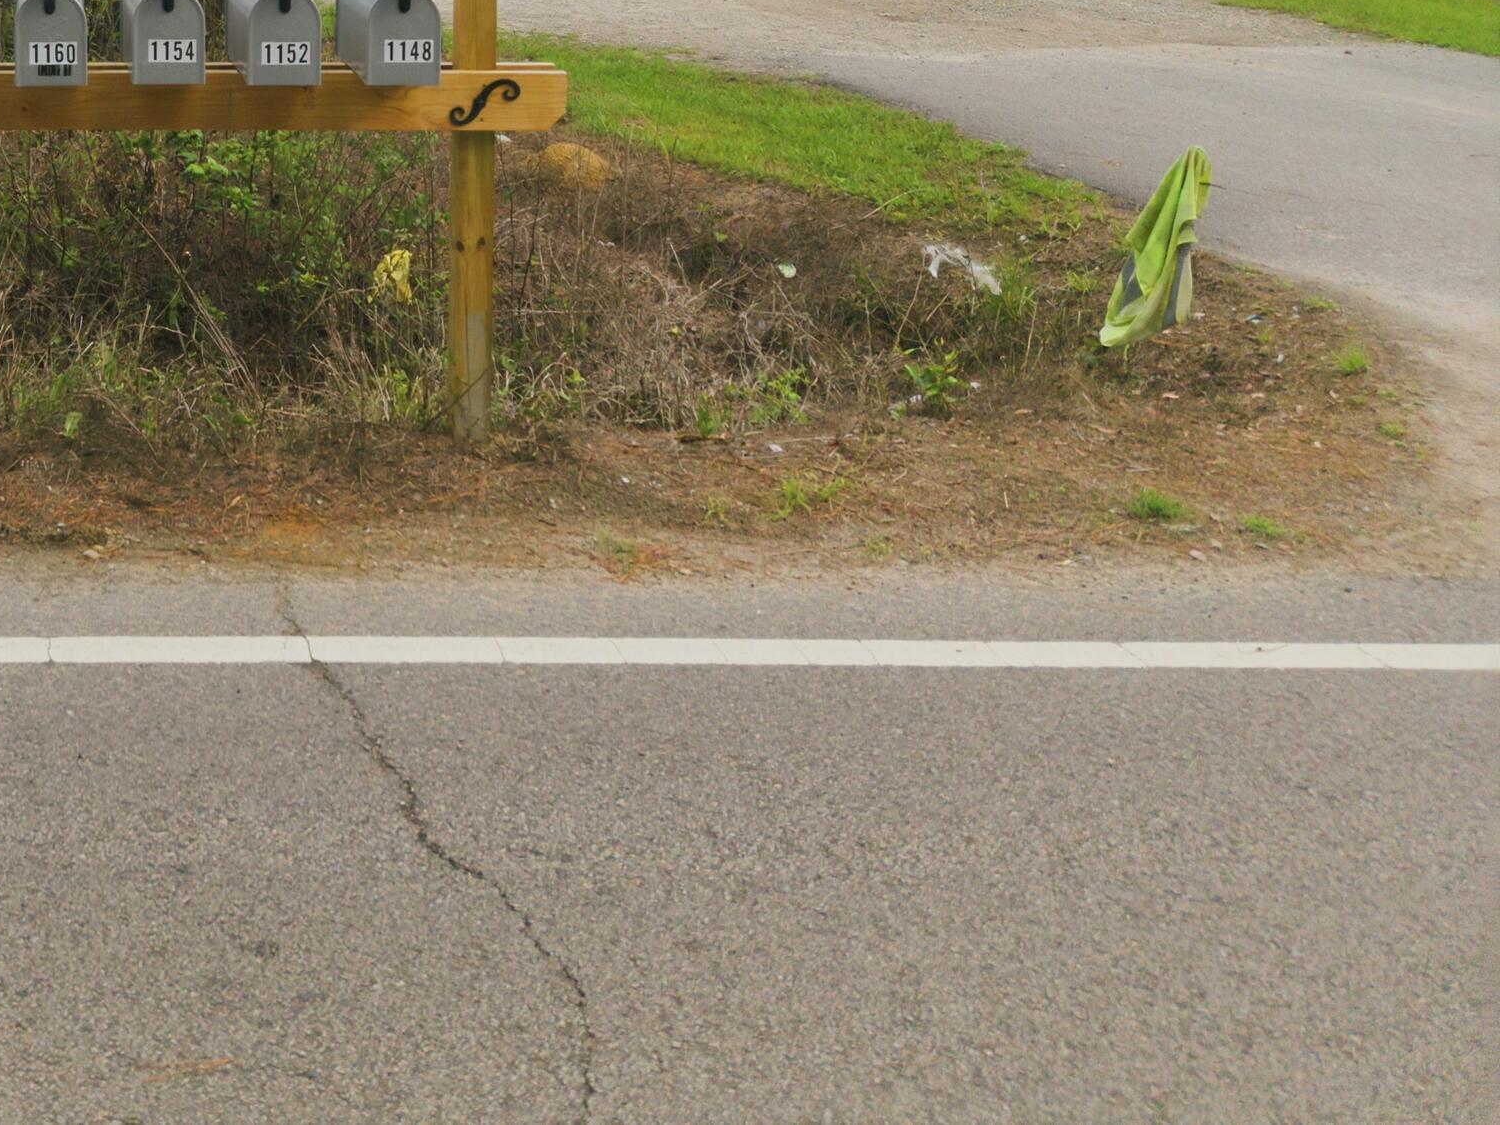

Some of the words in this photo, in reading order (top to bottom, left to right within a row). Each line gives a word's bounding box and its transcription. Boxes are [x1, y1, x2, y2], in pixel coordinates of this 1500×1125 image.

[32, 43, 76, 64] 1160
[151, 41, 195, 61] 1154
[264, 43, 308, 64] 1152
[387, 41, 431, 61] 1148
